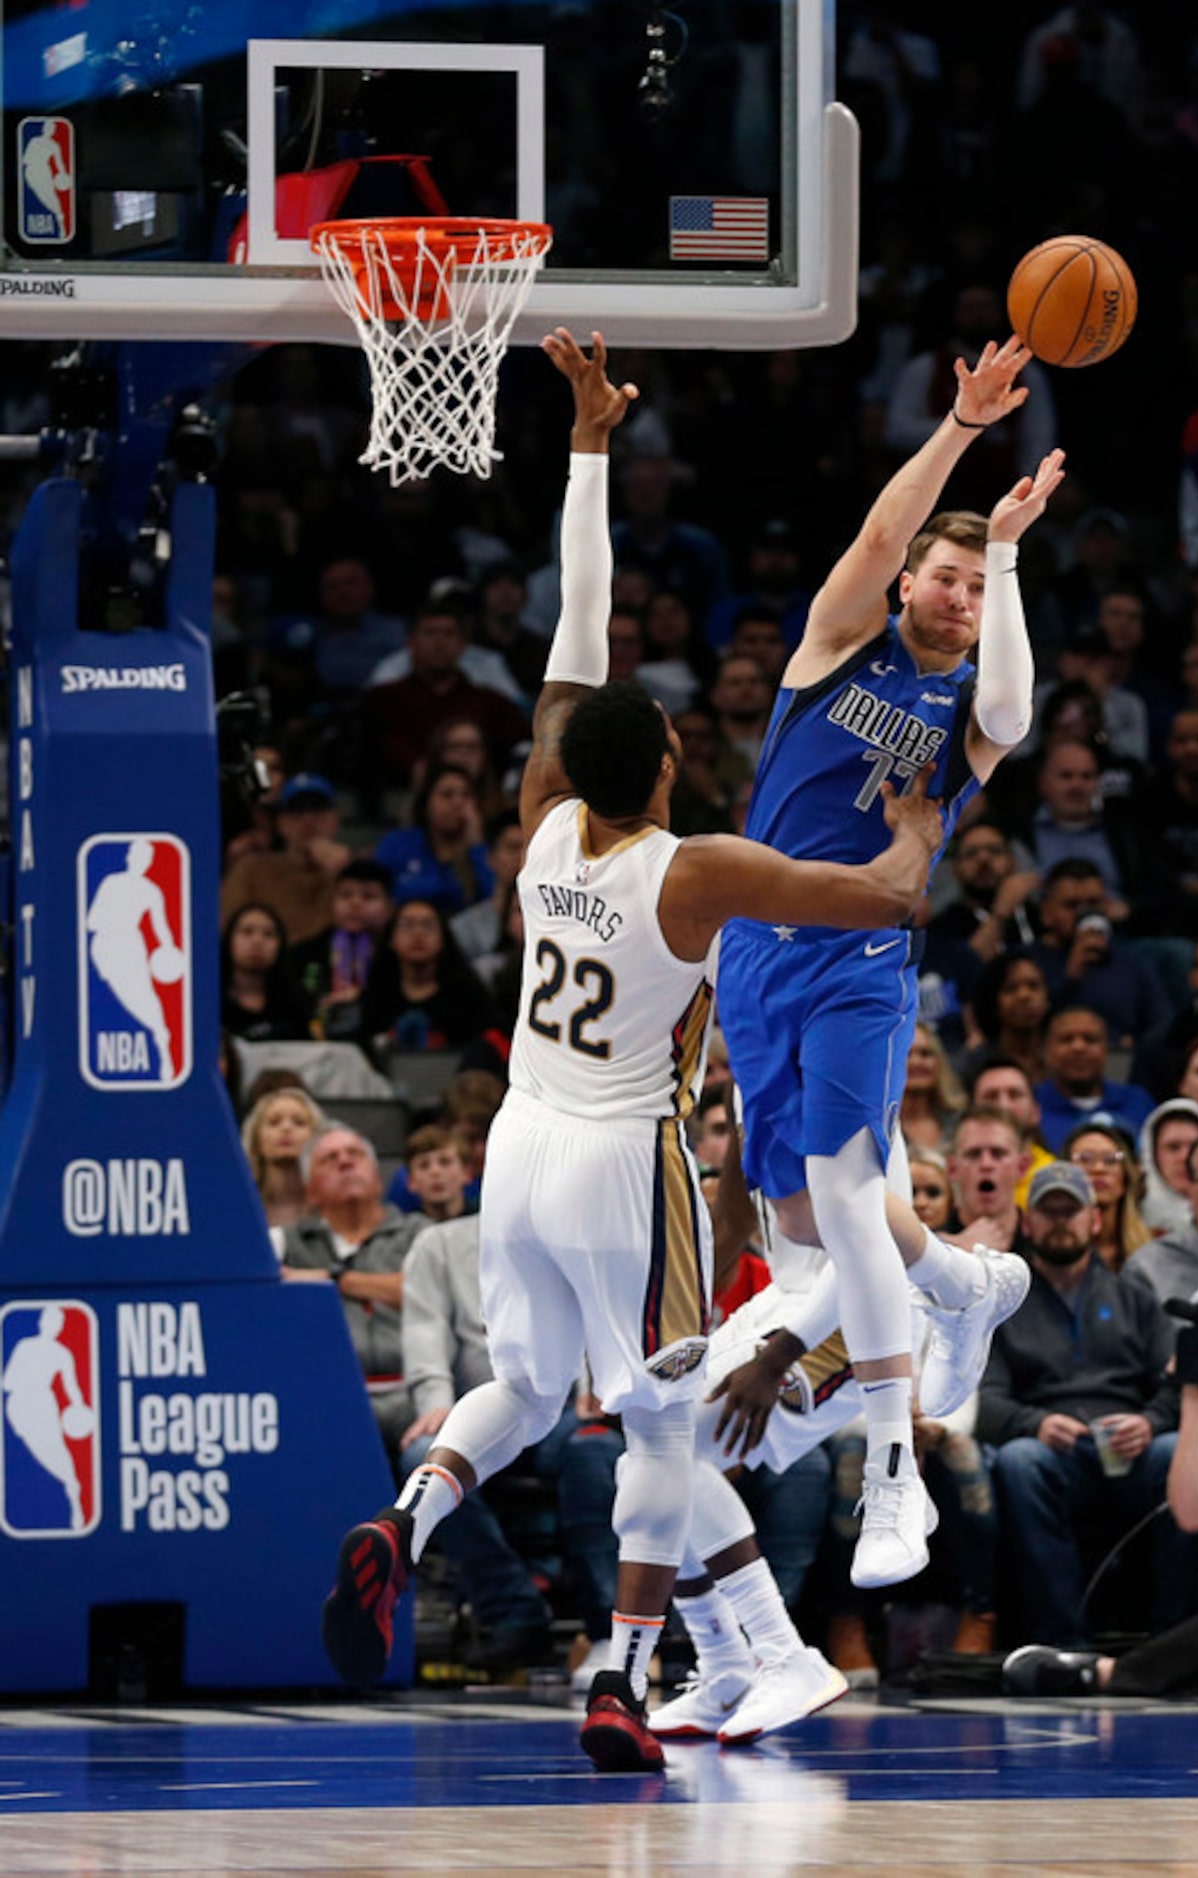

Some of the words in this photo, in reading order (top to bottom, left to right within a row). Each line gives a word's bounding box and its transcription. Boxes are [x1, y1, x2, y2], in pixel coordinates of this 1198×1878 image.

[0, 278, 76, 298] PALDING
[61, 664, 186, 693] SPALDING
[826, 682, 949, 767] DALLAS
[537, 883, 623, 943] FAVORS
[528, 936, 615, 1060] 22
[97, 1032, 150, 1073] NBA
[63, 1158, 190, 1236] @NBA
[117, 1302, 206, 1377] NBA
[119, 1380, 279, 1467] League
[121, 1456, 229, 1532] Pass
